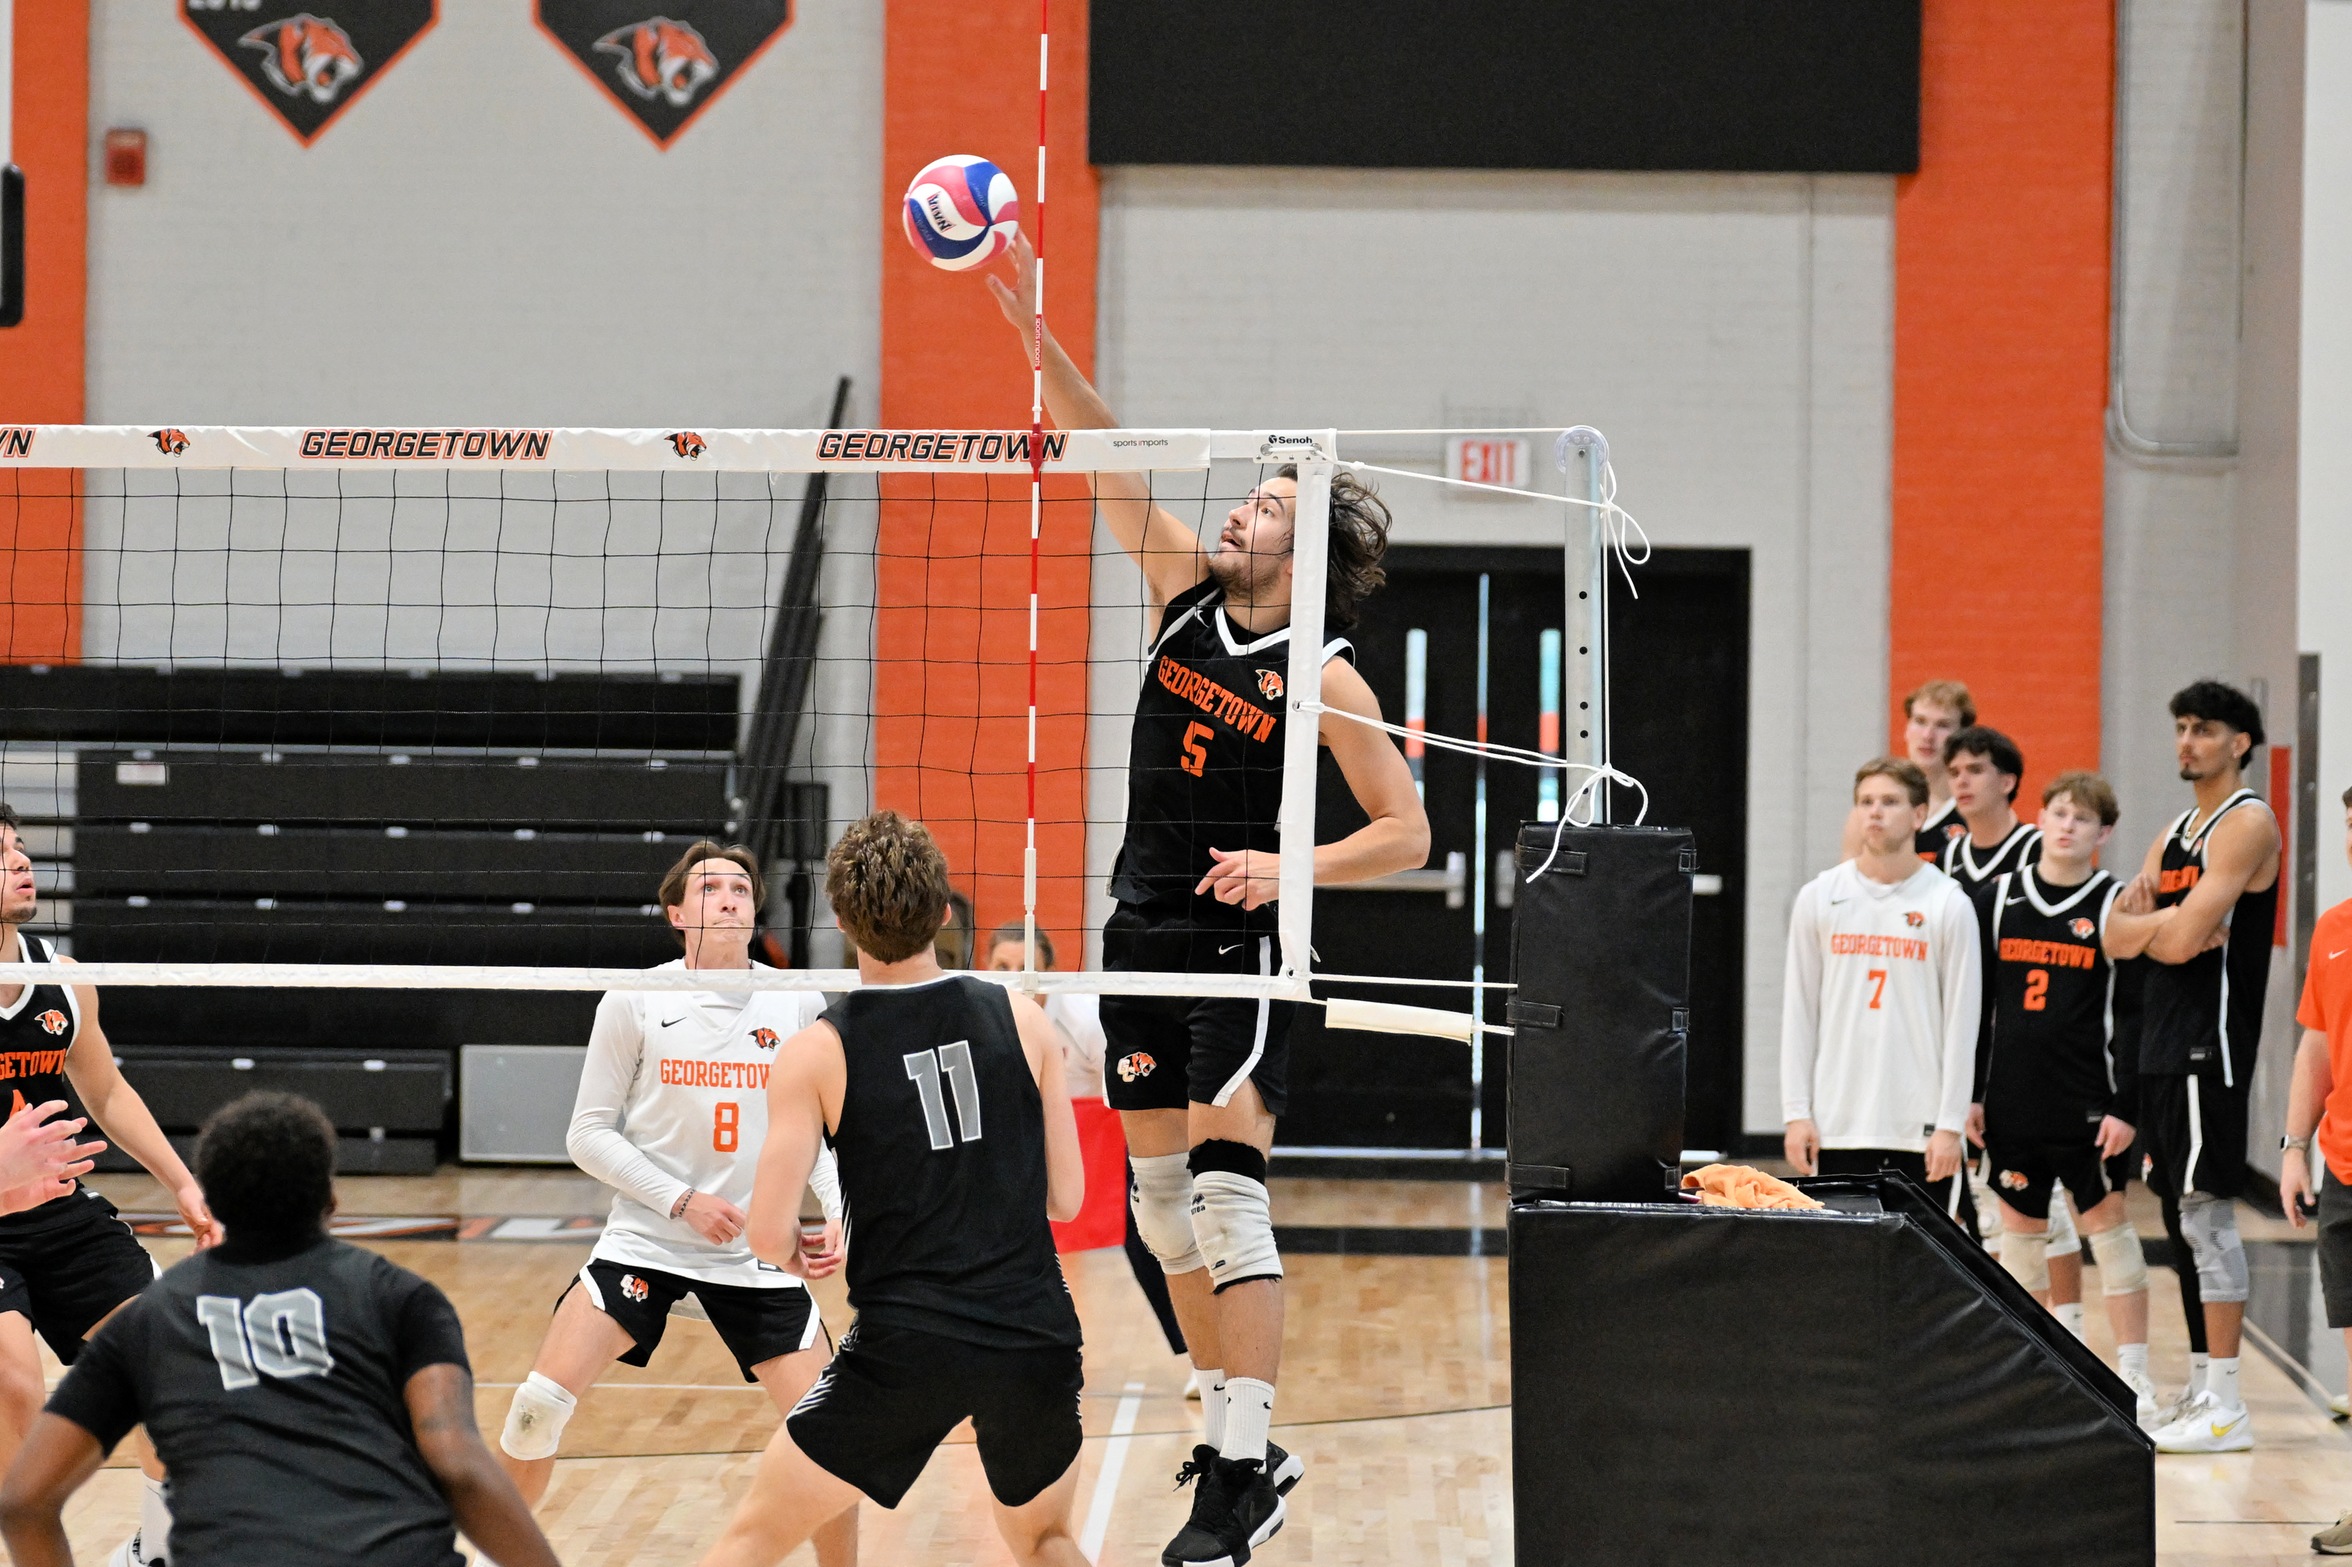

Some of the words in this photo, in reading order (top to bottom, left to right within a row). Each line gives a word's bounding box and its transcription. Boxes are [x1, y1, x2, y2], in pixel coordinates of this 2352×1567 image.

[299, 429, 553, 460] GEORGETOWN
[817, 430, 1070, 462] GEORGETOWN
[1113, 440, 1137, 448] sports
[1138, 439, 1168, 447] imports
[1278, 436, 1313, 444] Senoh
[1460, 440, 1516, 483] EXIT
[1157, 655, 1277, 743] GEORGETOWN
[1180, 720, 1215, 777] 5
[1831, 933, 1929, 961] GEORGETOWN
[1867, 969, 1887, 1009] 7
[2023, 968, 2050, 1011] 2
[660, 1058, 772, 1089] GEORGETO
[903, 1040, 982, 1150] 11
[713, 1102, 739, 1153] 8
[196, 1287, 335, 1391] 10
